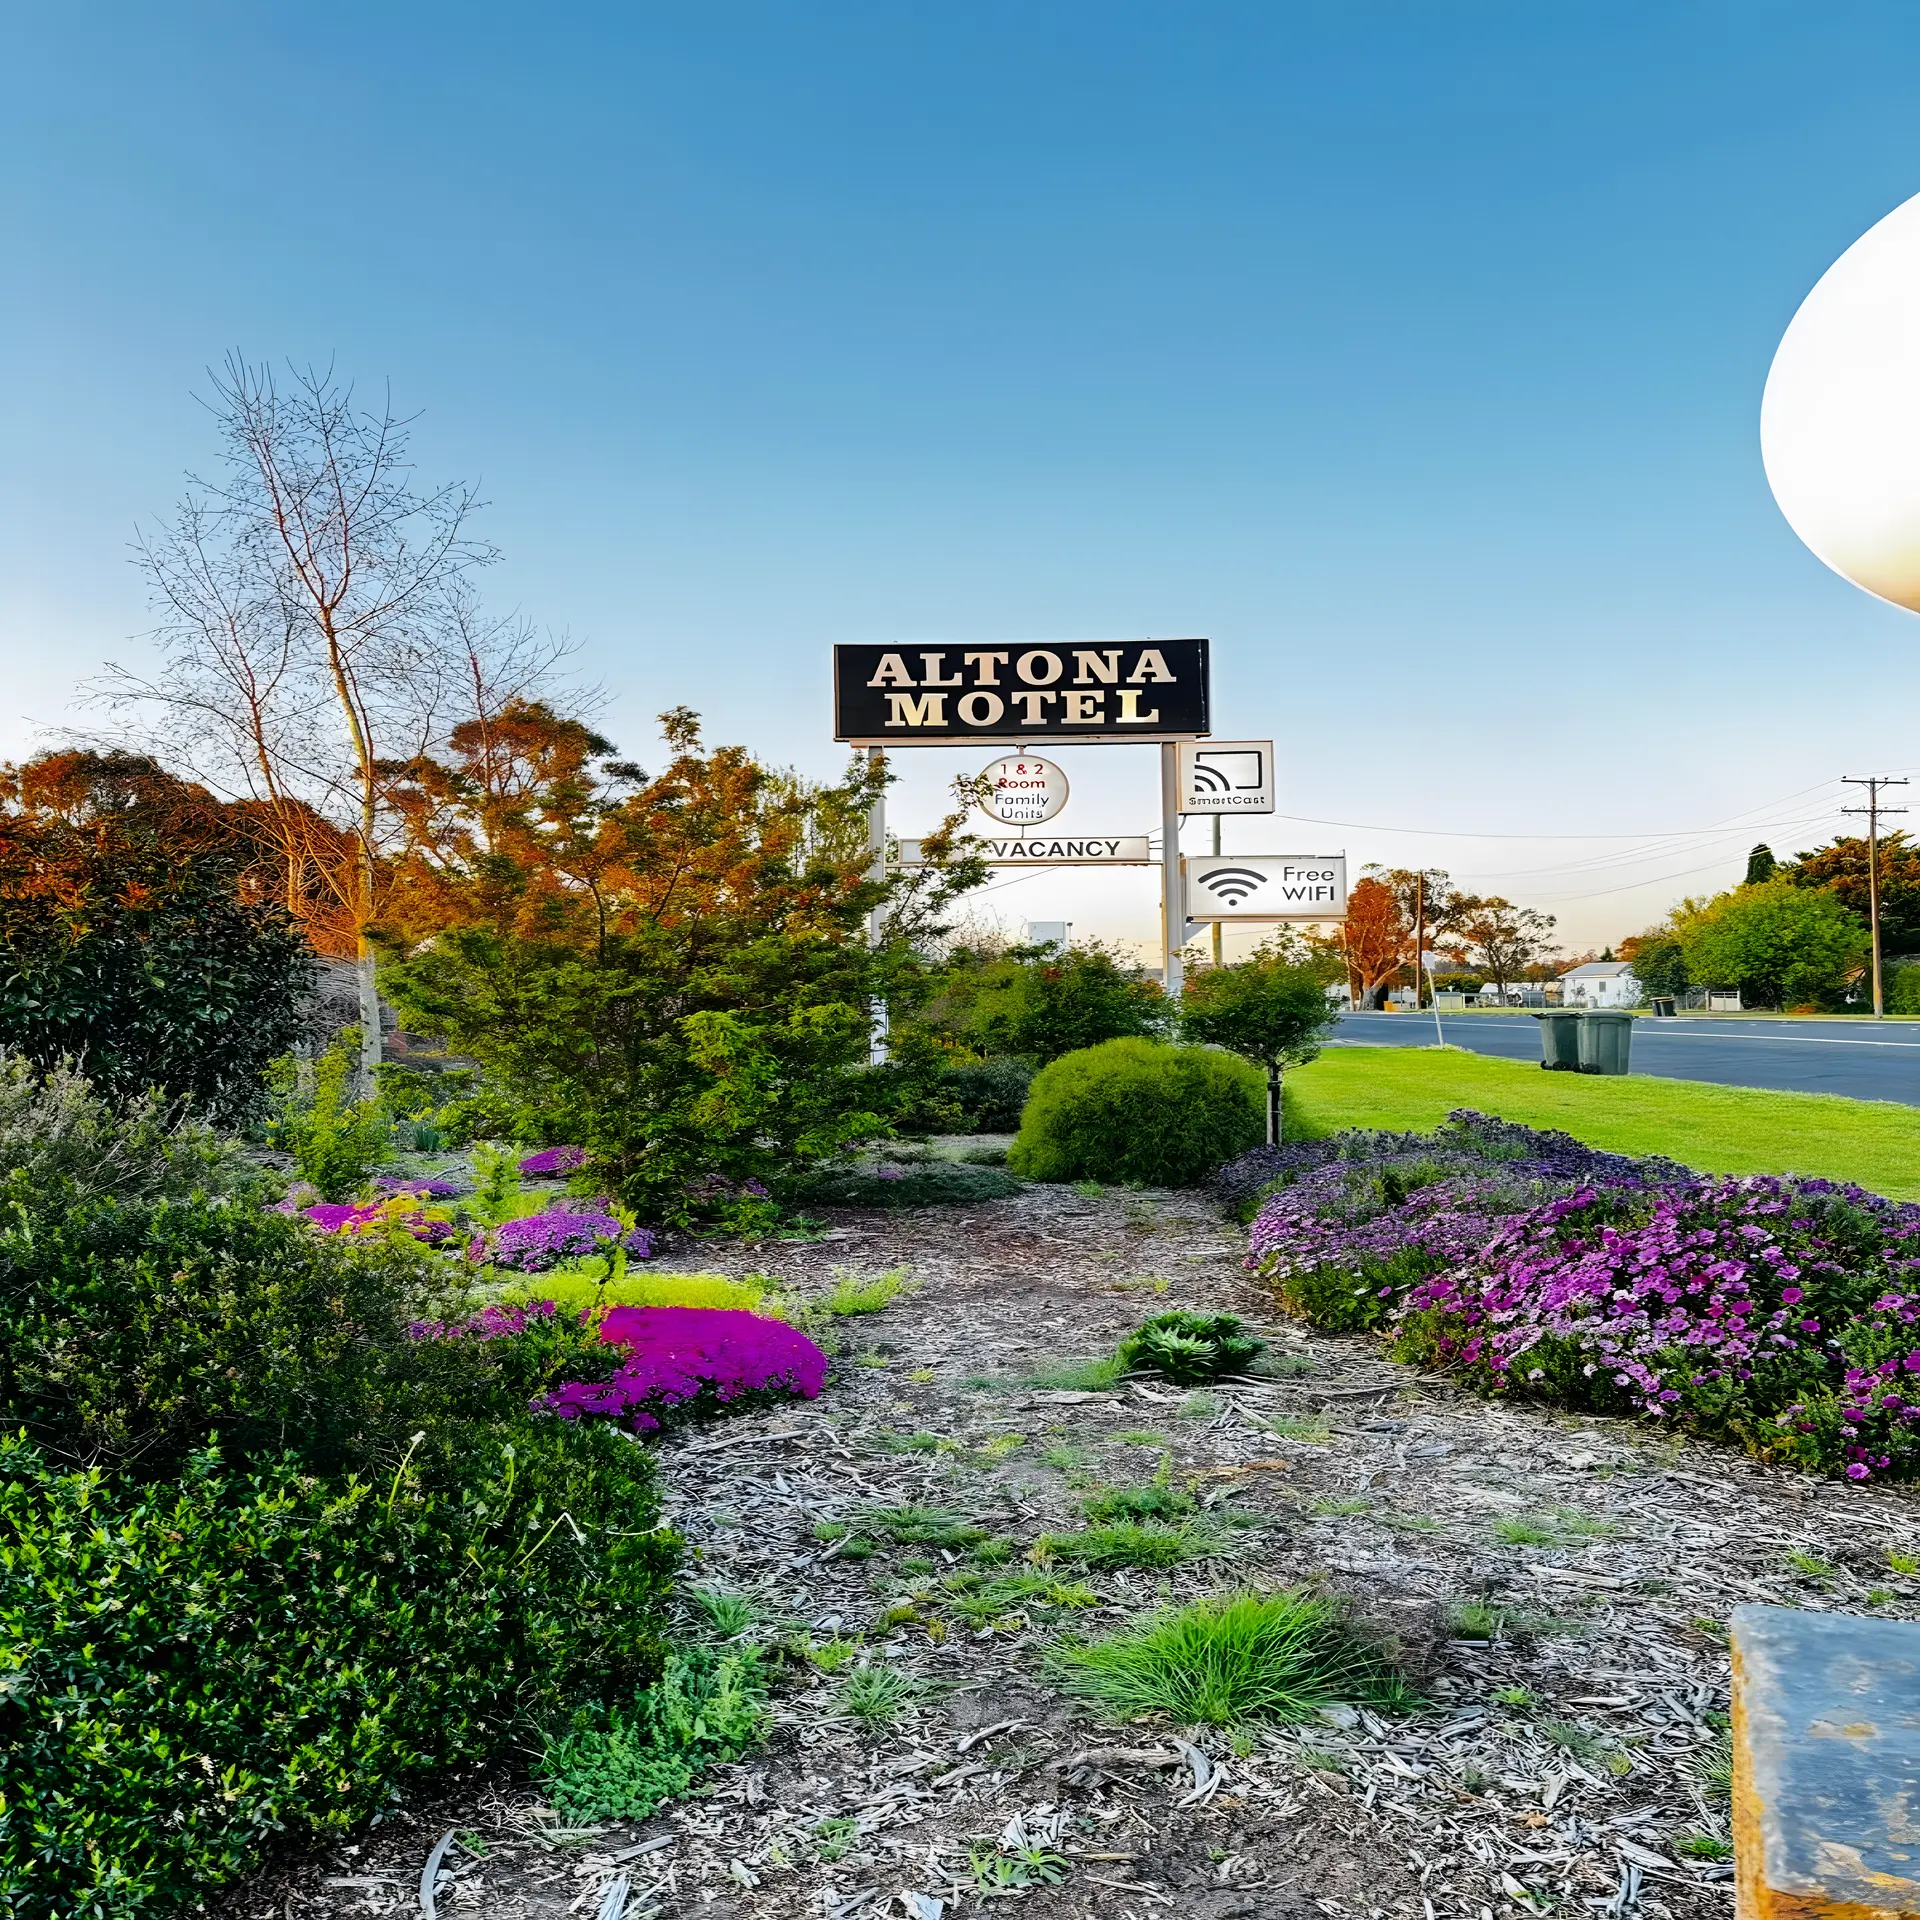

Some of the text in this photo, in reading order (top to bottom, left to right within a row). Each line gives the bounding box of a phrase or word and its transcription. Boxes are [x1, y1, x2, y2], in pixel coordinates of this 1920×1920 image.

[866, 649, 1177, 687] ALTONA
[884, 689, 1159, 726] MOTEL
[1000, 763, 1044, 775] 1 & 2
[998, 777, 1046, 789] Room
[995, 793, 1049, 807] Family
[1001, 807, 1043, 819] Units
[990, 840, 1121, 858] VACANCY
[1283, 866, 1335, 881] Free
[1282, 886, 1335, 901] WIFI
